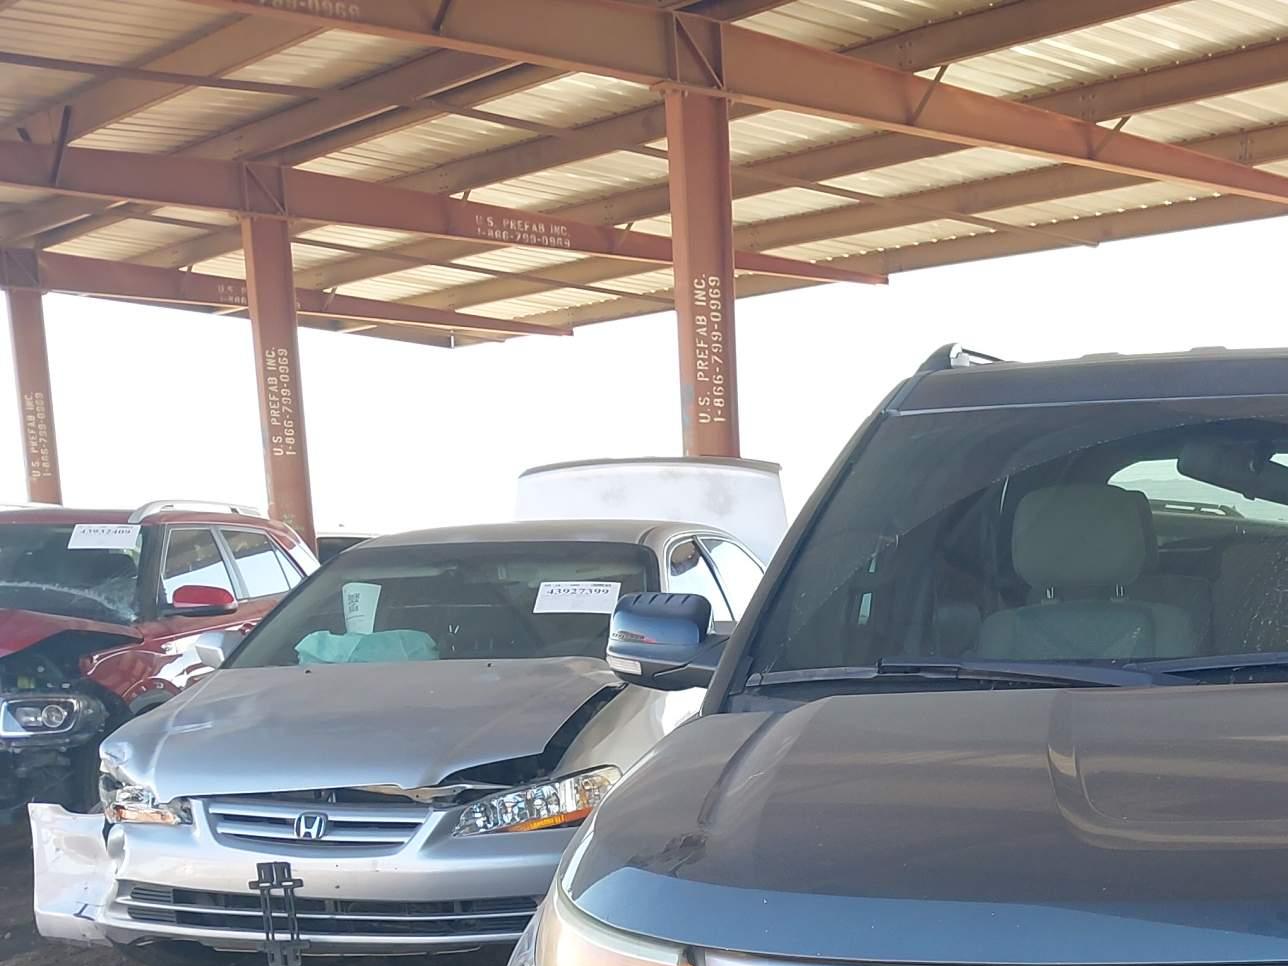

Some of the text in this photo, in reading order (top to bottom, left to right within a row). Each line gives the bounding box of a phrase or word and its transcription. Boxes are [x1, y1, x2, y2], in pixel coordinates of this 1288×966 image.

[502, 218, 545, 234] PREFAB
[265, 347, 277, 371] INC.
[694, 273, 711, 423] U.S. PREFAB INC.
[708, 275, 726, 422] 1-866-799-0969
[267, 376, 281, 425] PREFAB
[277, 348, 297, 456] 1-866-799-0969
